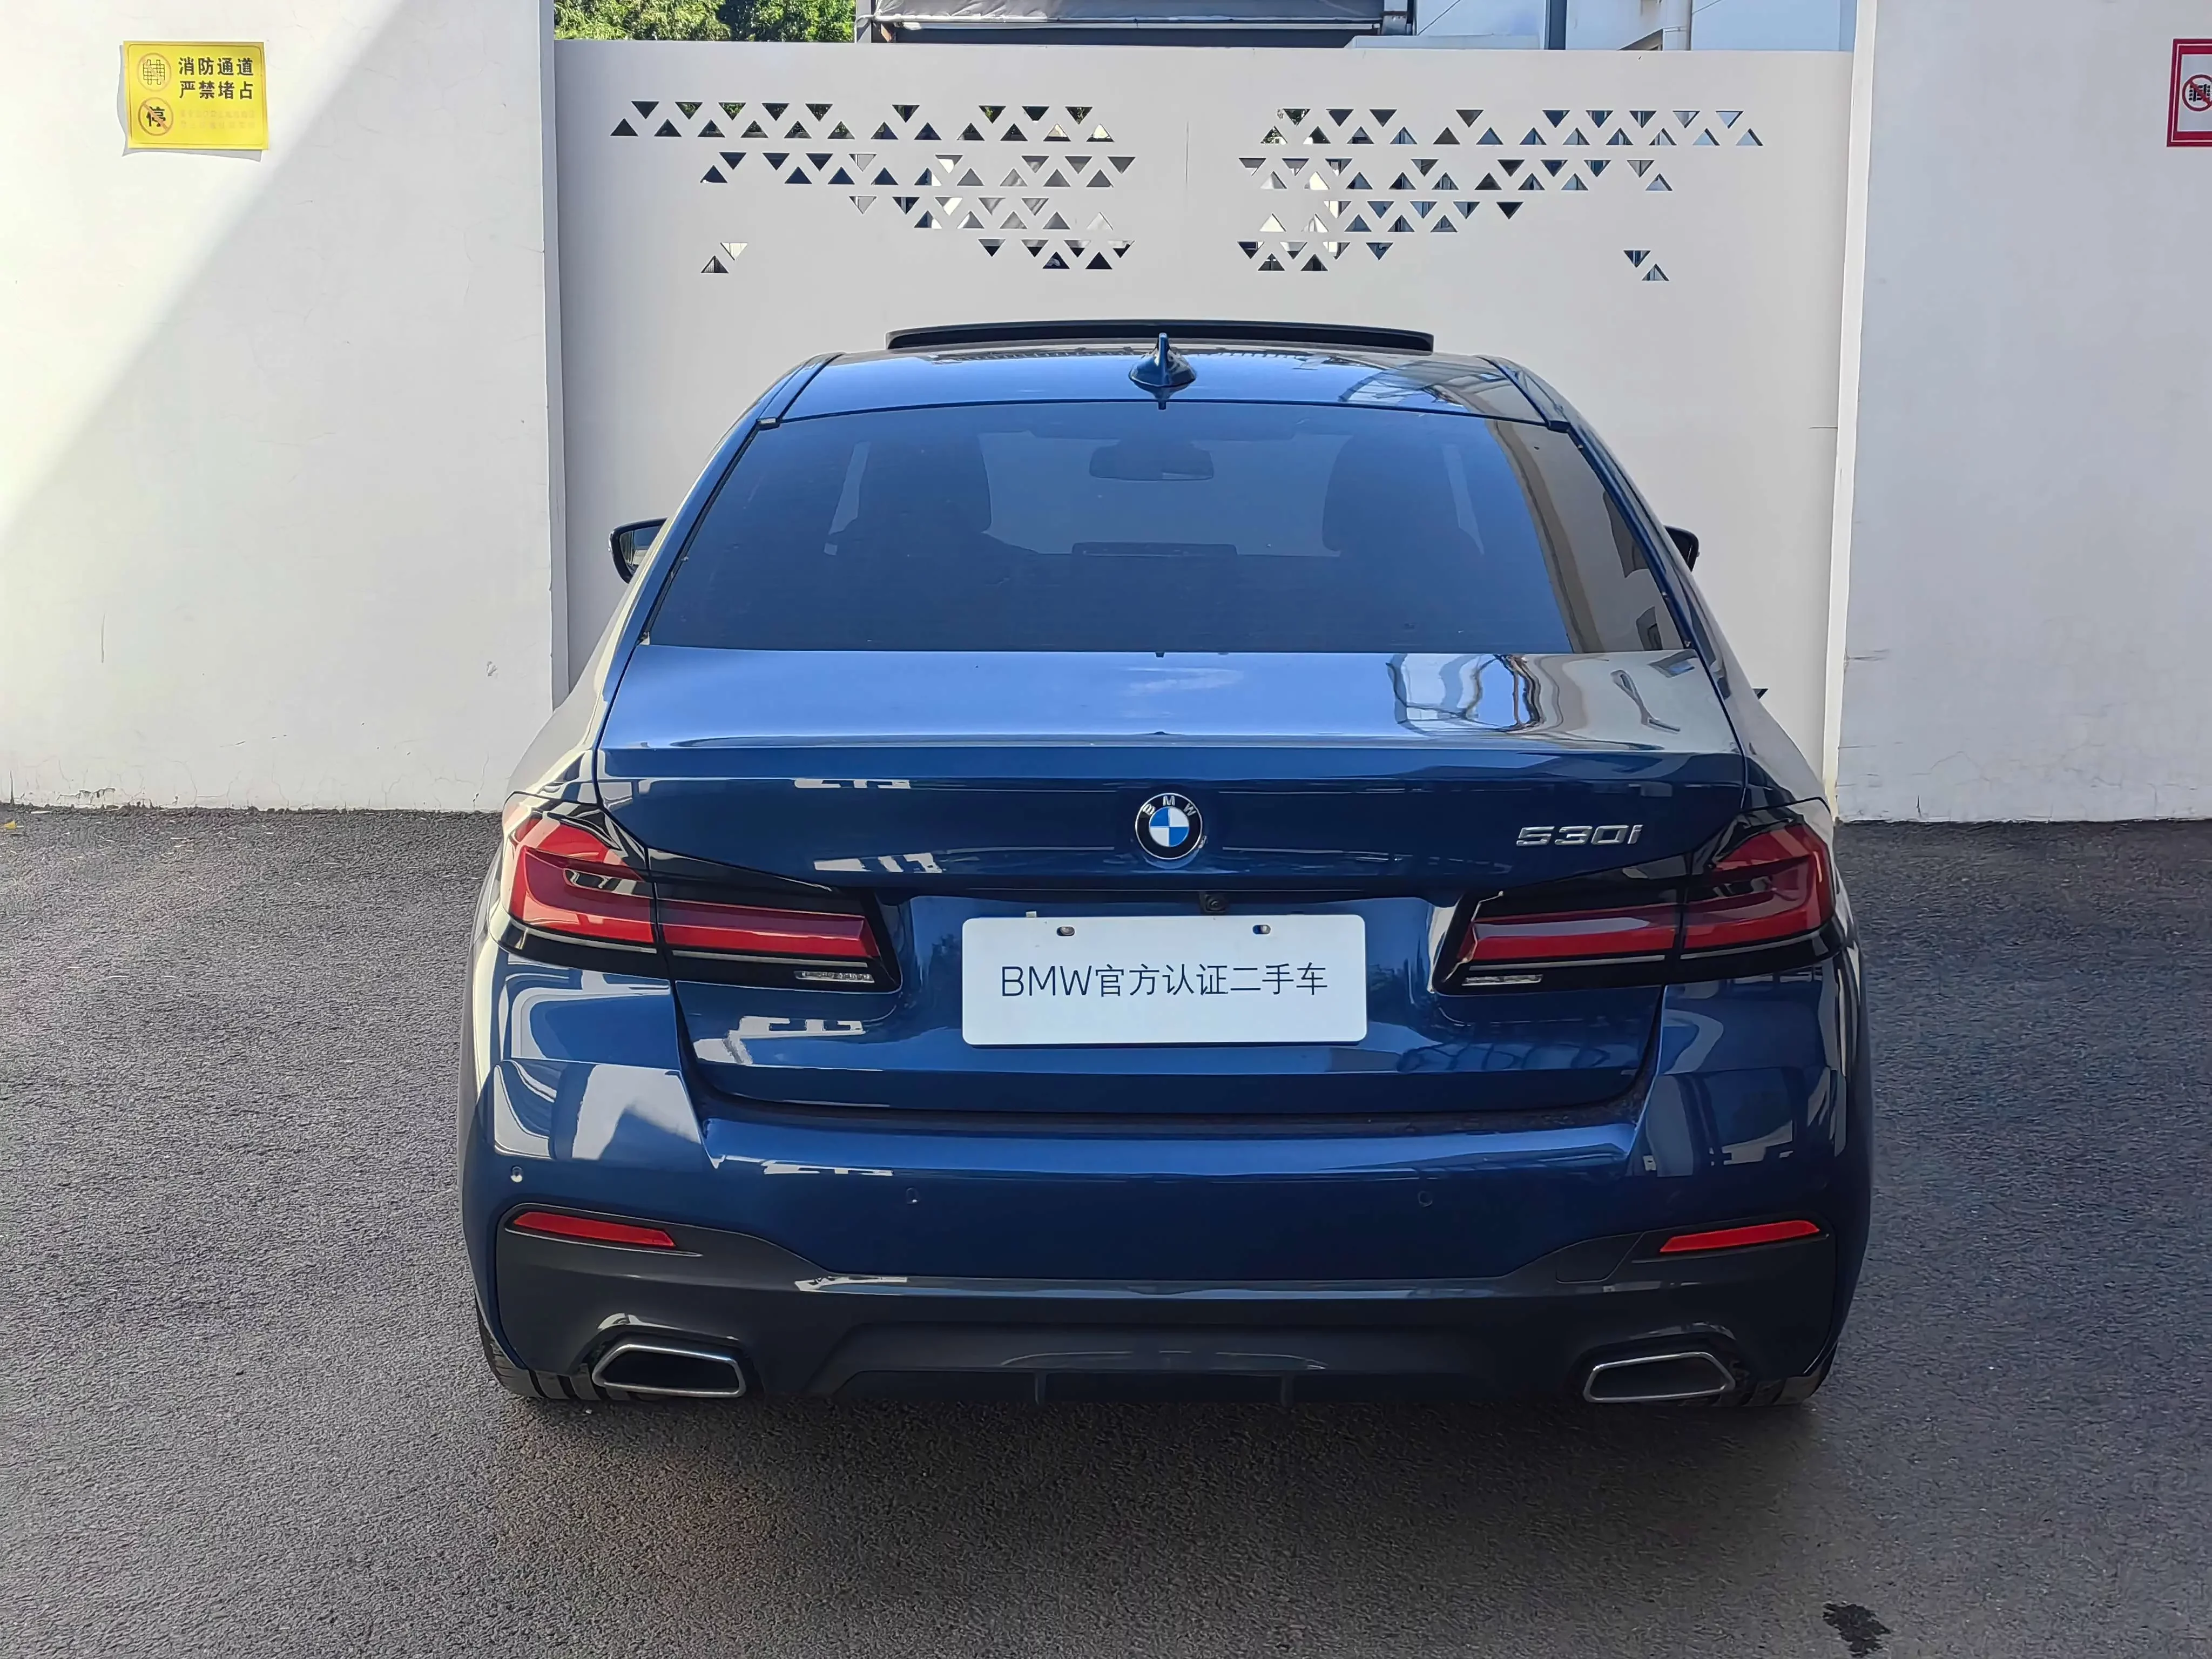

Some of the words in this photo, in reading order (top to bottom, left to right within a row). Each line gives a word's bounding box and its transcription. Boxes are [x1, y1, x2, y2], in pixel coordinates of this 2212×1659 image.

[178, 56, 254, 76] 消防通道
[179, 81, 253, 99] 严禁堵占
[1142, 795, 1197, 817] BMW
[1516, 824, 1643, 846] 530i
